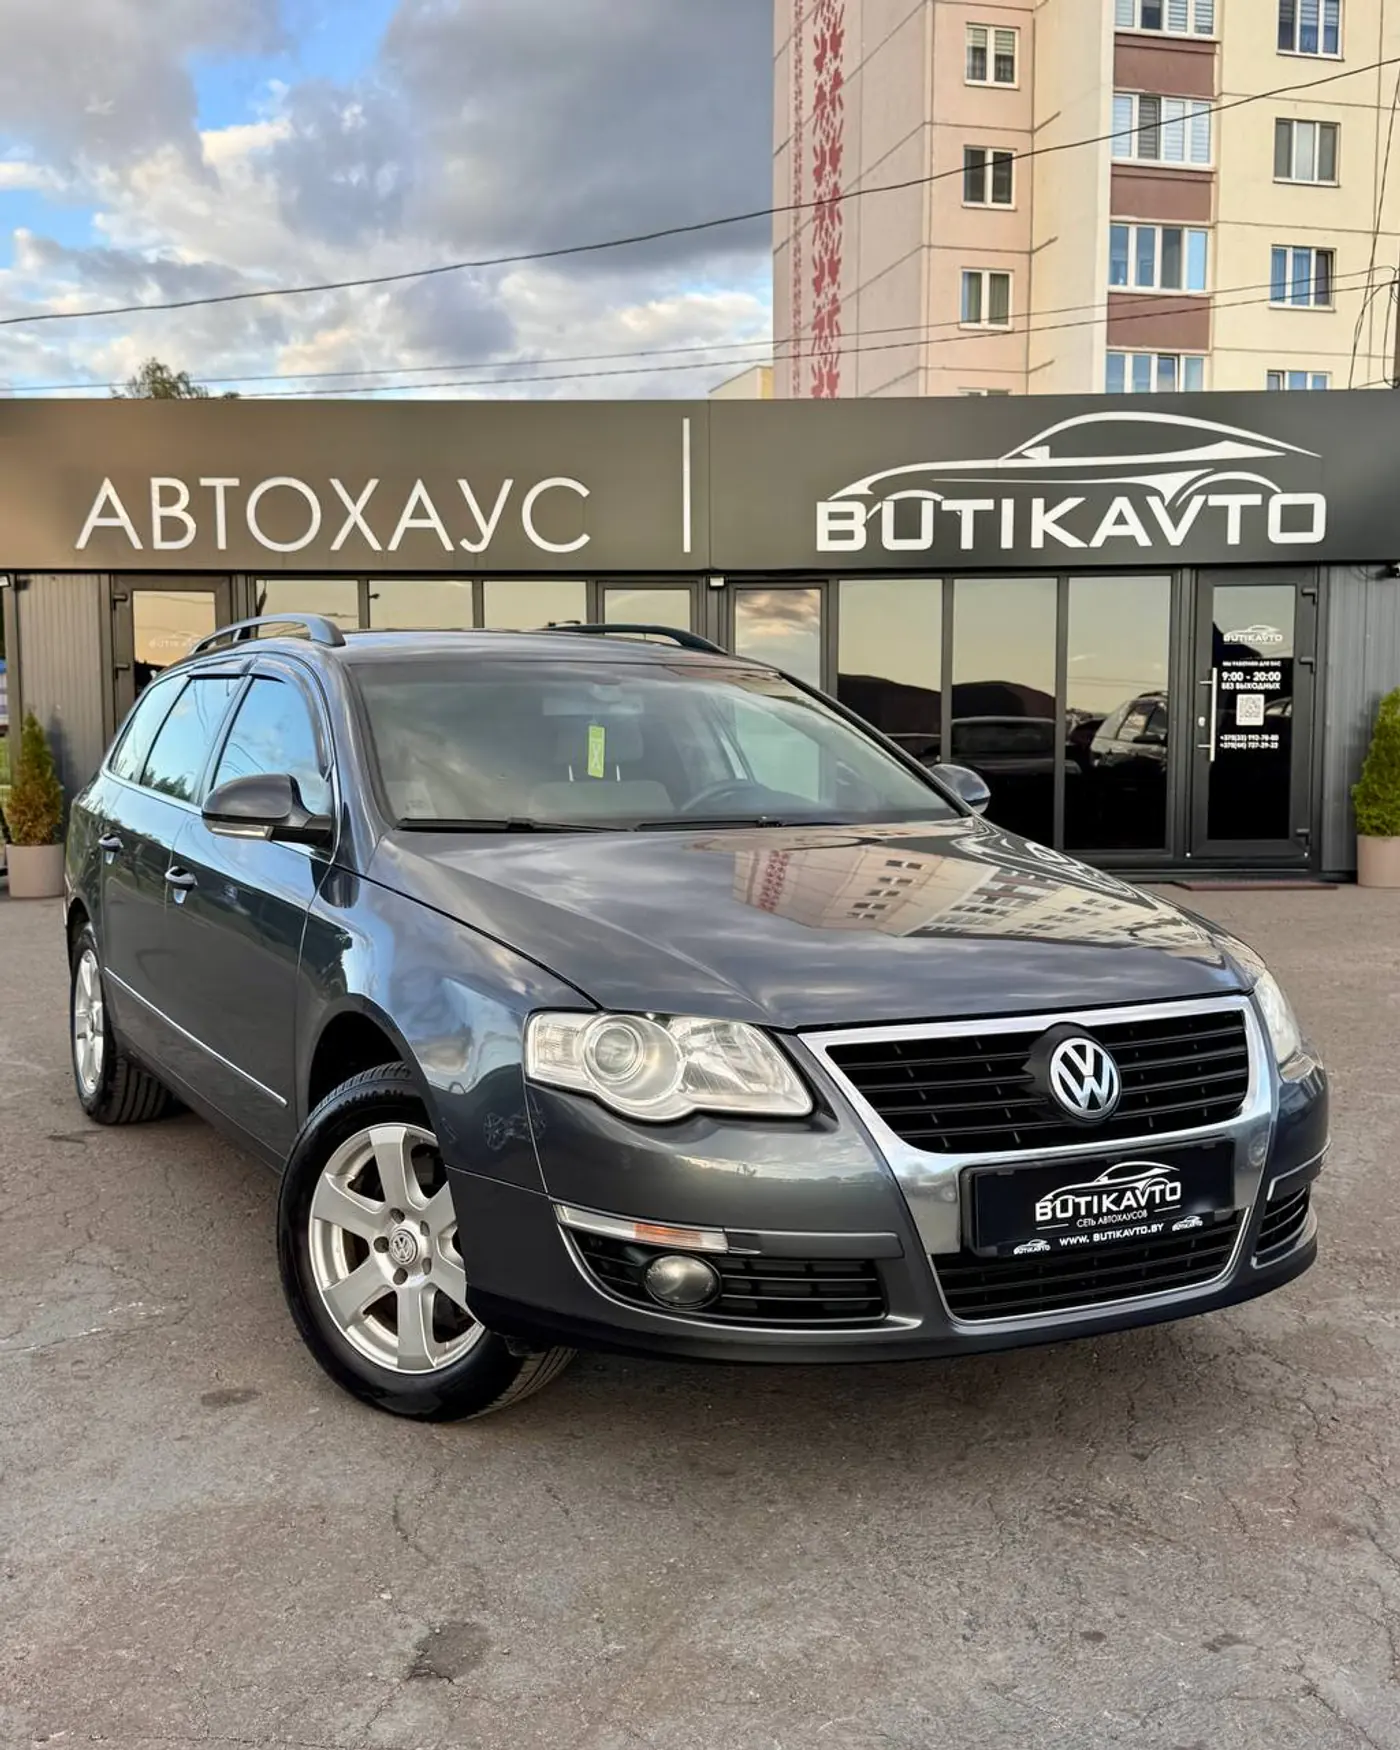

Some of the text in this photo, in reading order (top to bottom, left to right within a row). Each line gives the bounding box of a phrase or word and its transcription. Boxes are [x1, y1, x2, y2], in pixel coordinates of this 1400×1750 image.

[75, 476, 591, 553] АВТОХАУС
[816, 491, 1327, 553] BUTIKAVTO
[1223, 633, 1283, 643] BUTIKAVTO
[1222, 671, 1244, 682] 9:00
[1252, 671, 1281, 682] 20:00
[1235, 682, 1281, 690] ВЫХОДНЫХ
[1035, 1181, 1182, 1222] BUTIKAVTO
[1076, 1209, 1148, 1228] СЕТЬ АВТОХАУСОВ
[1060, 1223, 1165, 1247] WWW. BUTIKAVTO.BY
